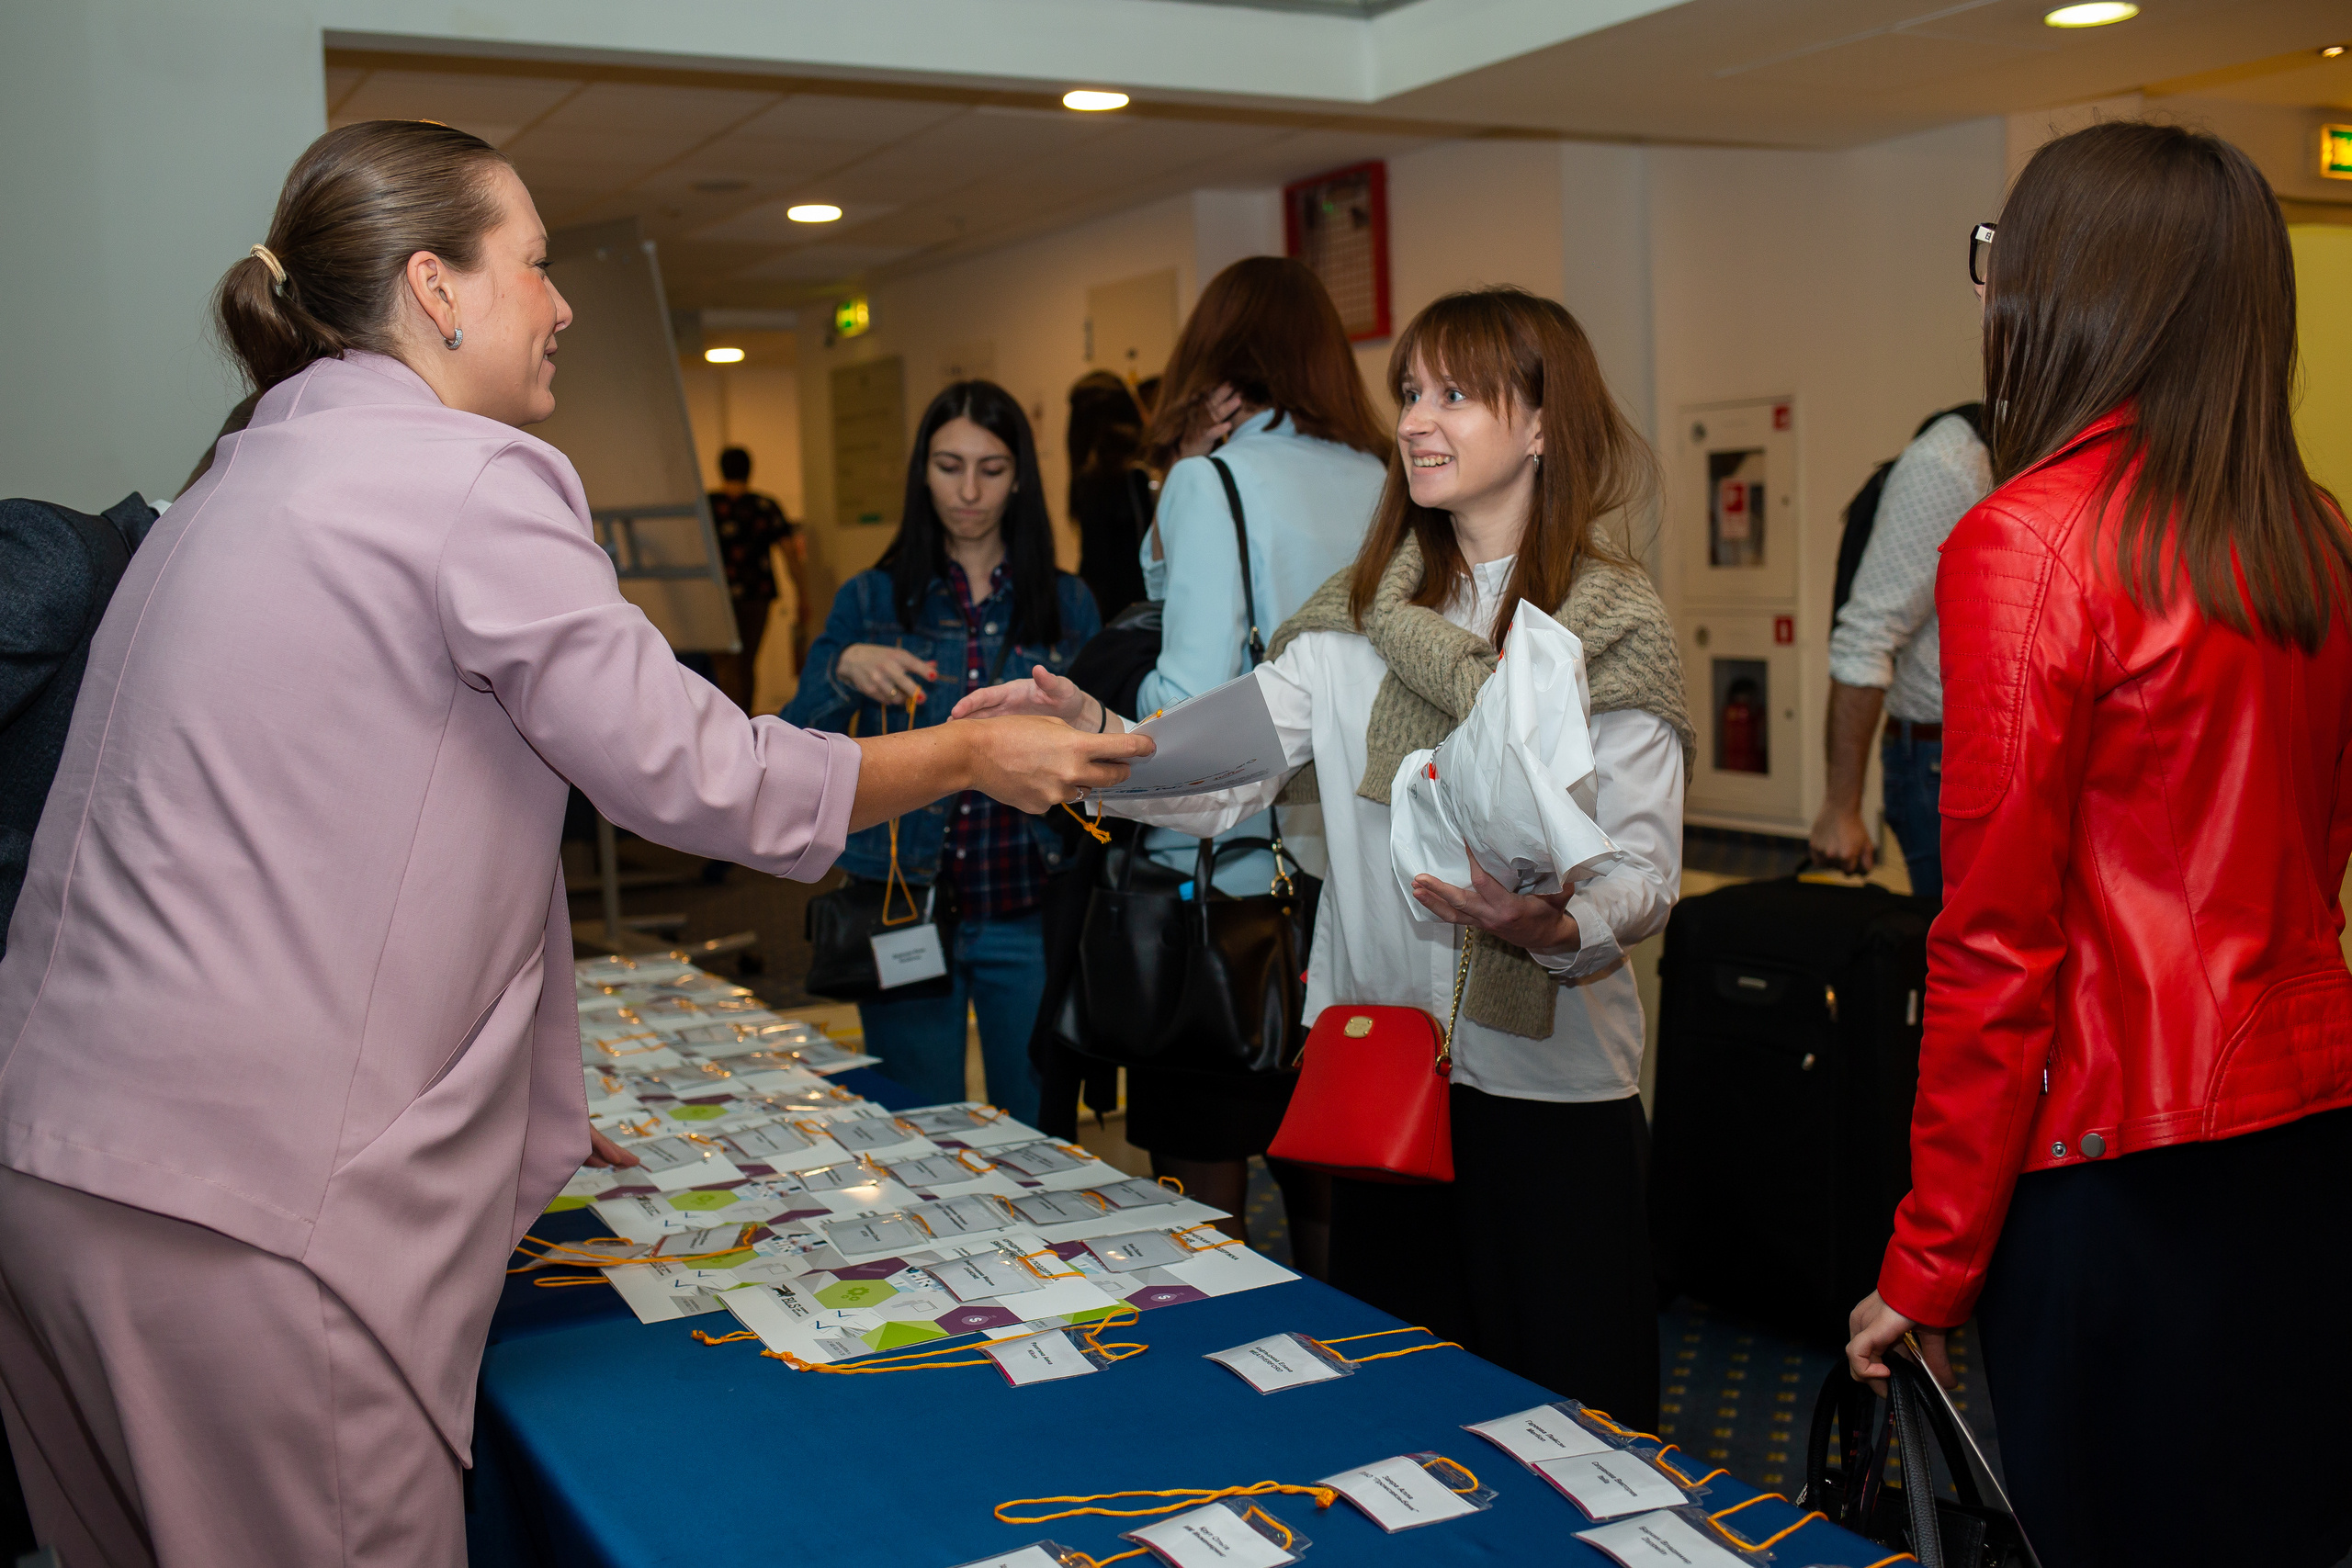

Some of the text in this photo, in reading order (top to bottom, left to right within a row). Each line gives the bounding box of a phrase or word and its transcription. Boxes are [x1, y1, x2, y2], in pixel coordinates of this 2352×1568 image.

[963, 1267, 980, 1280] DANONE
[1249, 1348, 1283, 1372] WEATHERFORD
[1278, 1361, 1294, 1372] Елена
